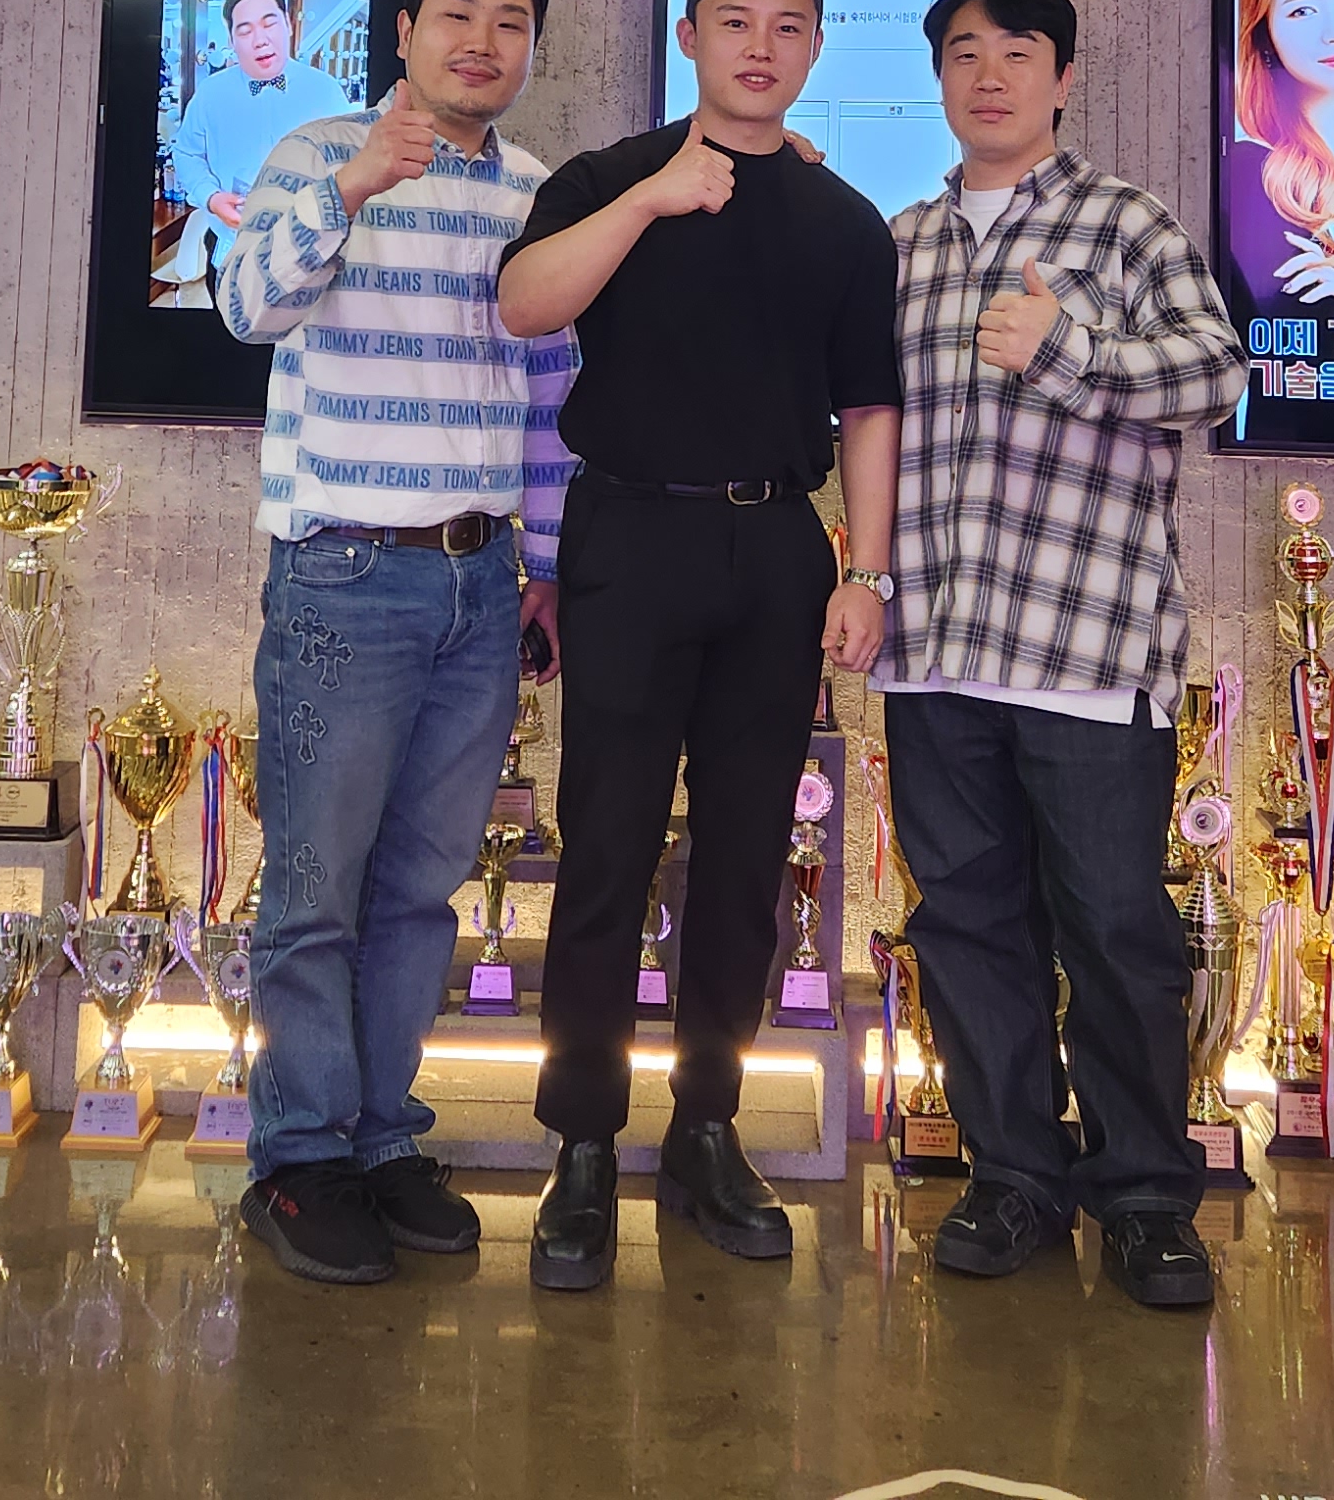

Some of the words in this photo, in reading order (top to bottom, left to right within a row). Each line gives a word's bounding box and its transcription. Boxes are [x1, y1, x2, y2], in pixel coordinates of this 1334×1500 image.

[368, 207, 416, 230] JEANS
[471, 214, 516, 239] TOMMY
[374, 270, 422, 292] JEANS
[318, 328, 368, 354] TOMMY
[375, 334, 423, 358] JEANS
[1248, 319, 1317, 357] 이제
[317, 393, 368, 421] TOMMY
[375, 400, 430, 423] JEANS
[309, 457, 369, 484] TOMMY
[375, 466, 430, 488] JEANS
